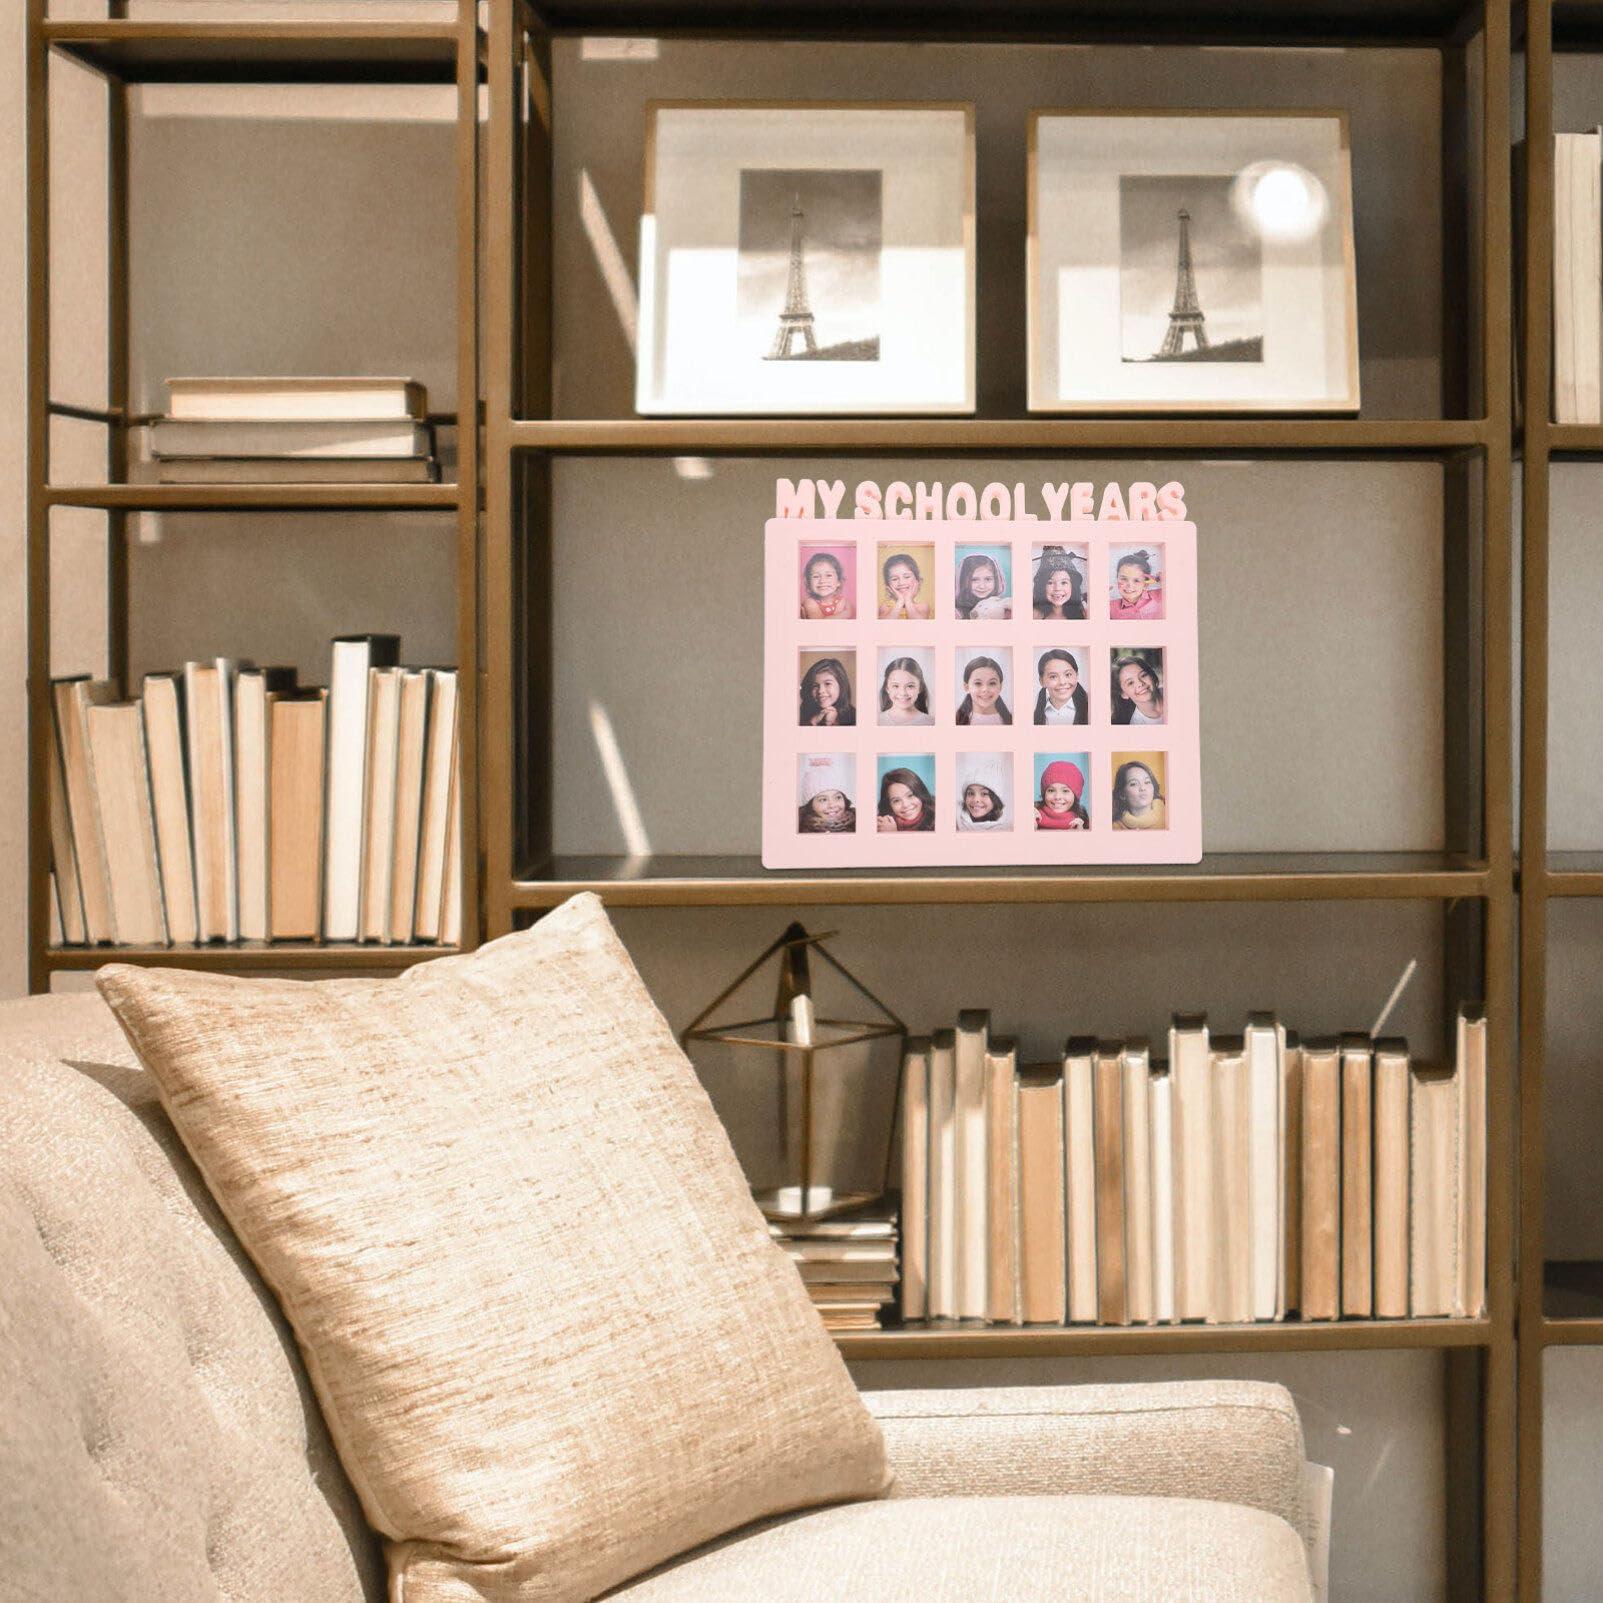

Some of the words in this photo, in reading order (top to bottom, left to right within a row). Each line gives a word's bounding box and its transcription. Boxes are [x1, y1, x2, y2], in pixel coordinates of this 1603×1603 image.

[776, 478, 846, 519] MY
[854, 481, 1038, 520] SCHOOL
[1041, 481, 1187, 521] YEARS
